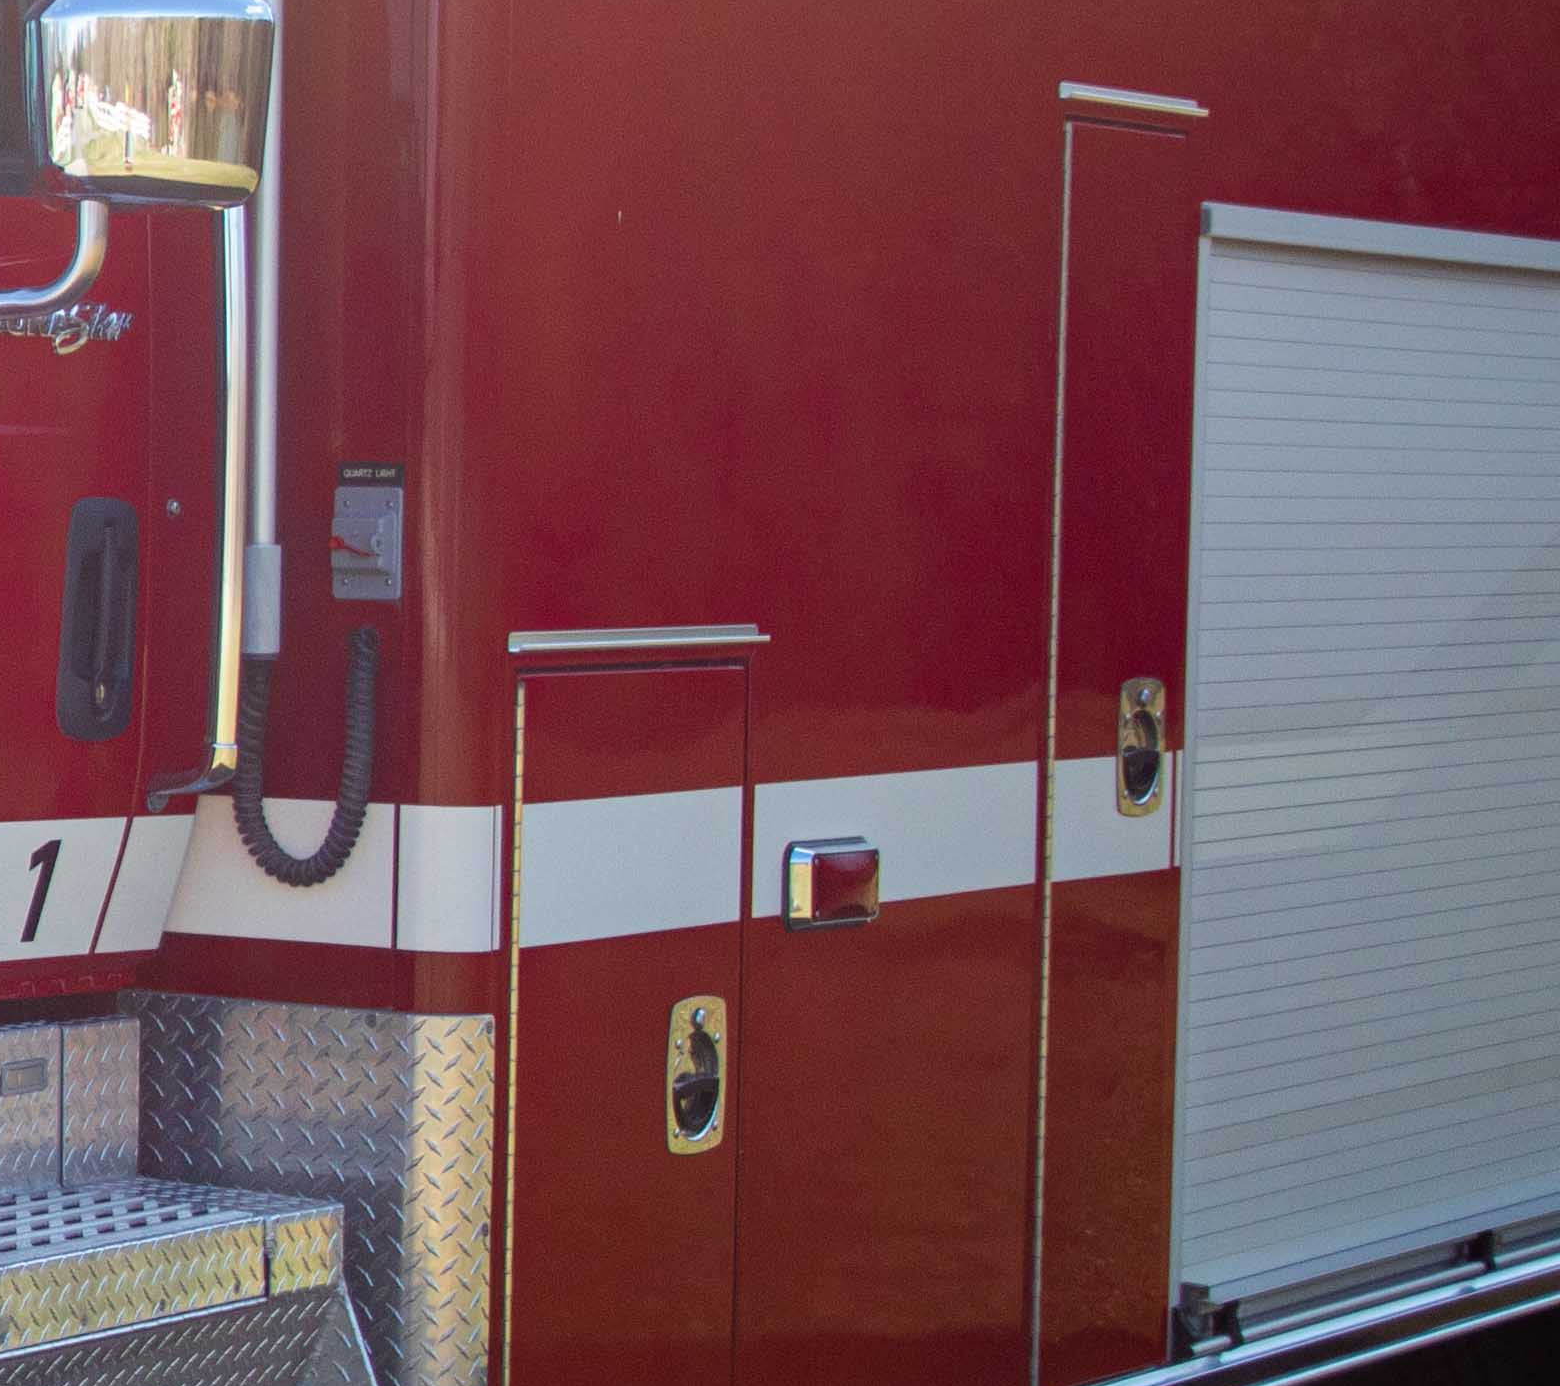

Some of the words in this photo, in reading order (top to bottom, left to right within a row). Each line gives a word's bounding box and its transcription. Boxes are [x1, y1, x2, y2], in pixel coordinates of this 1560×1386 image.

[343, 468, 373, 478] QUARTZ
[375, 468, 396, 478] LIGHT
[21, 839, 62, 943] 1
